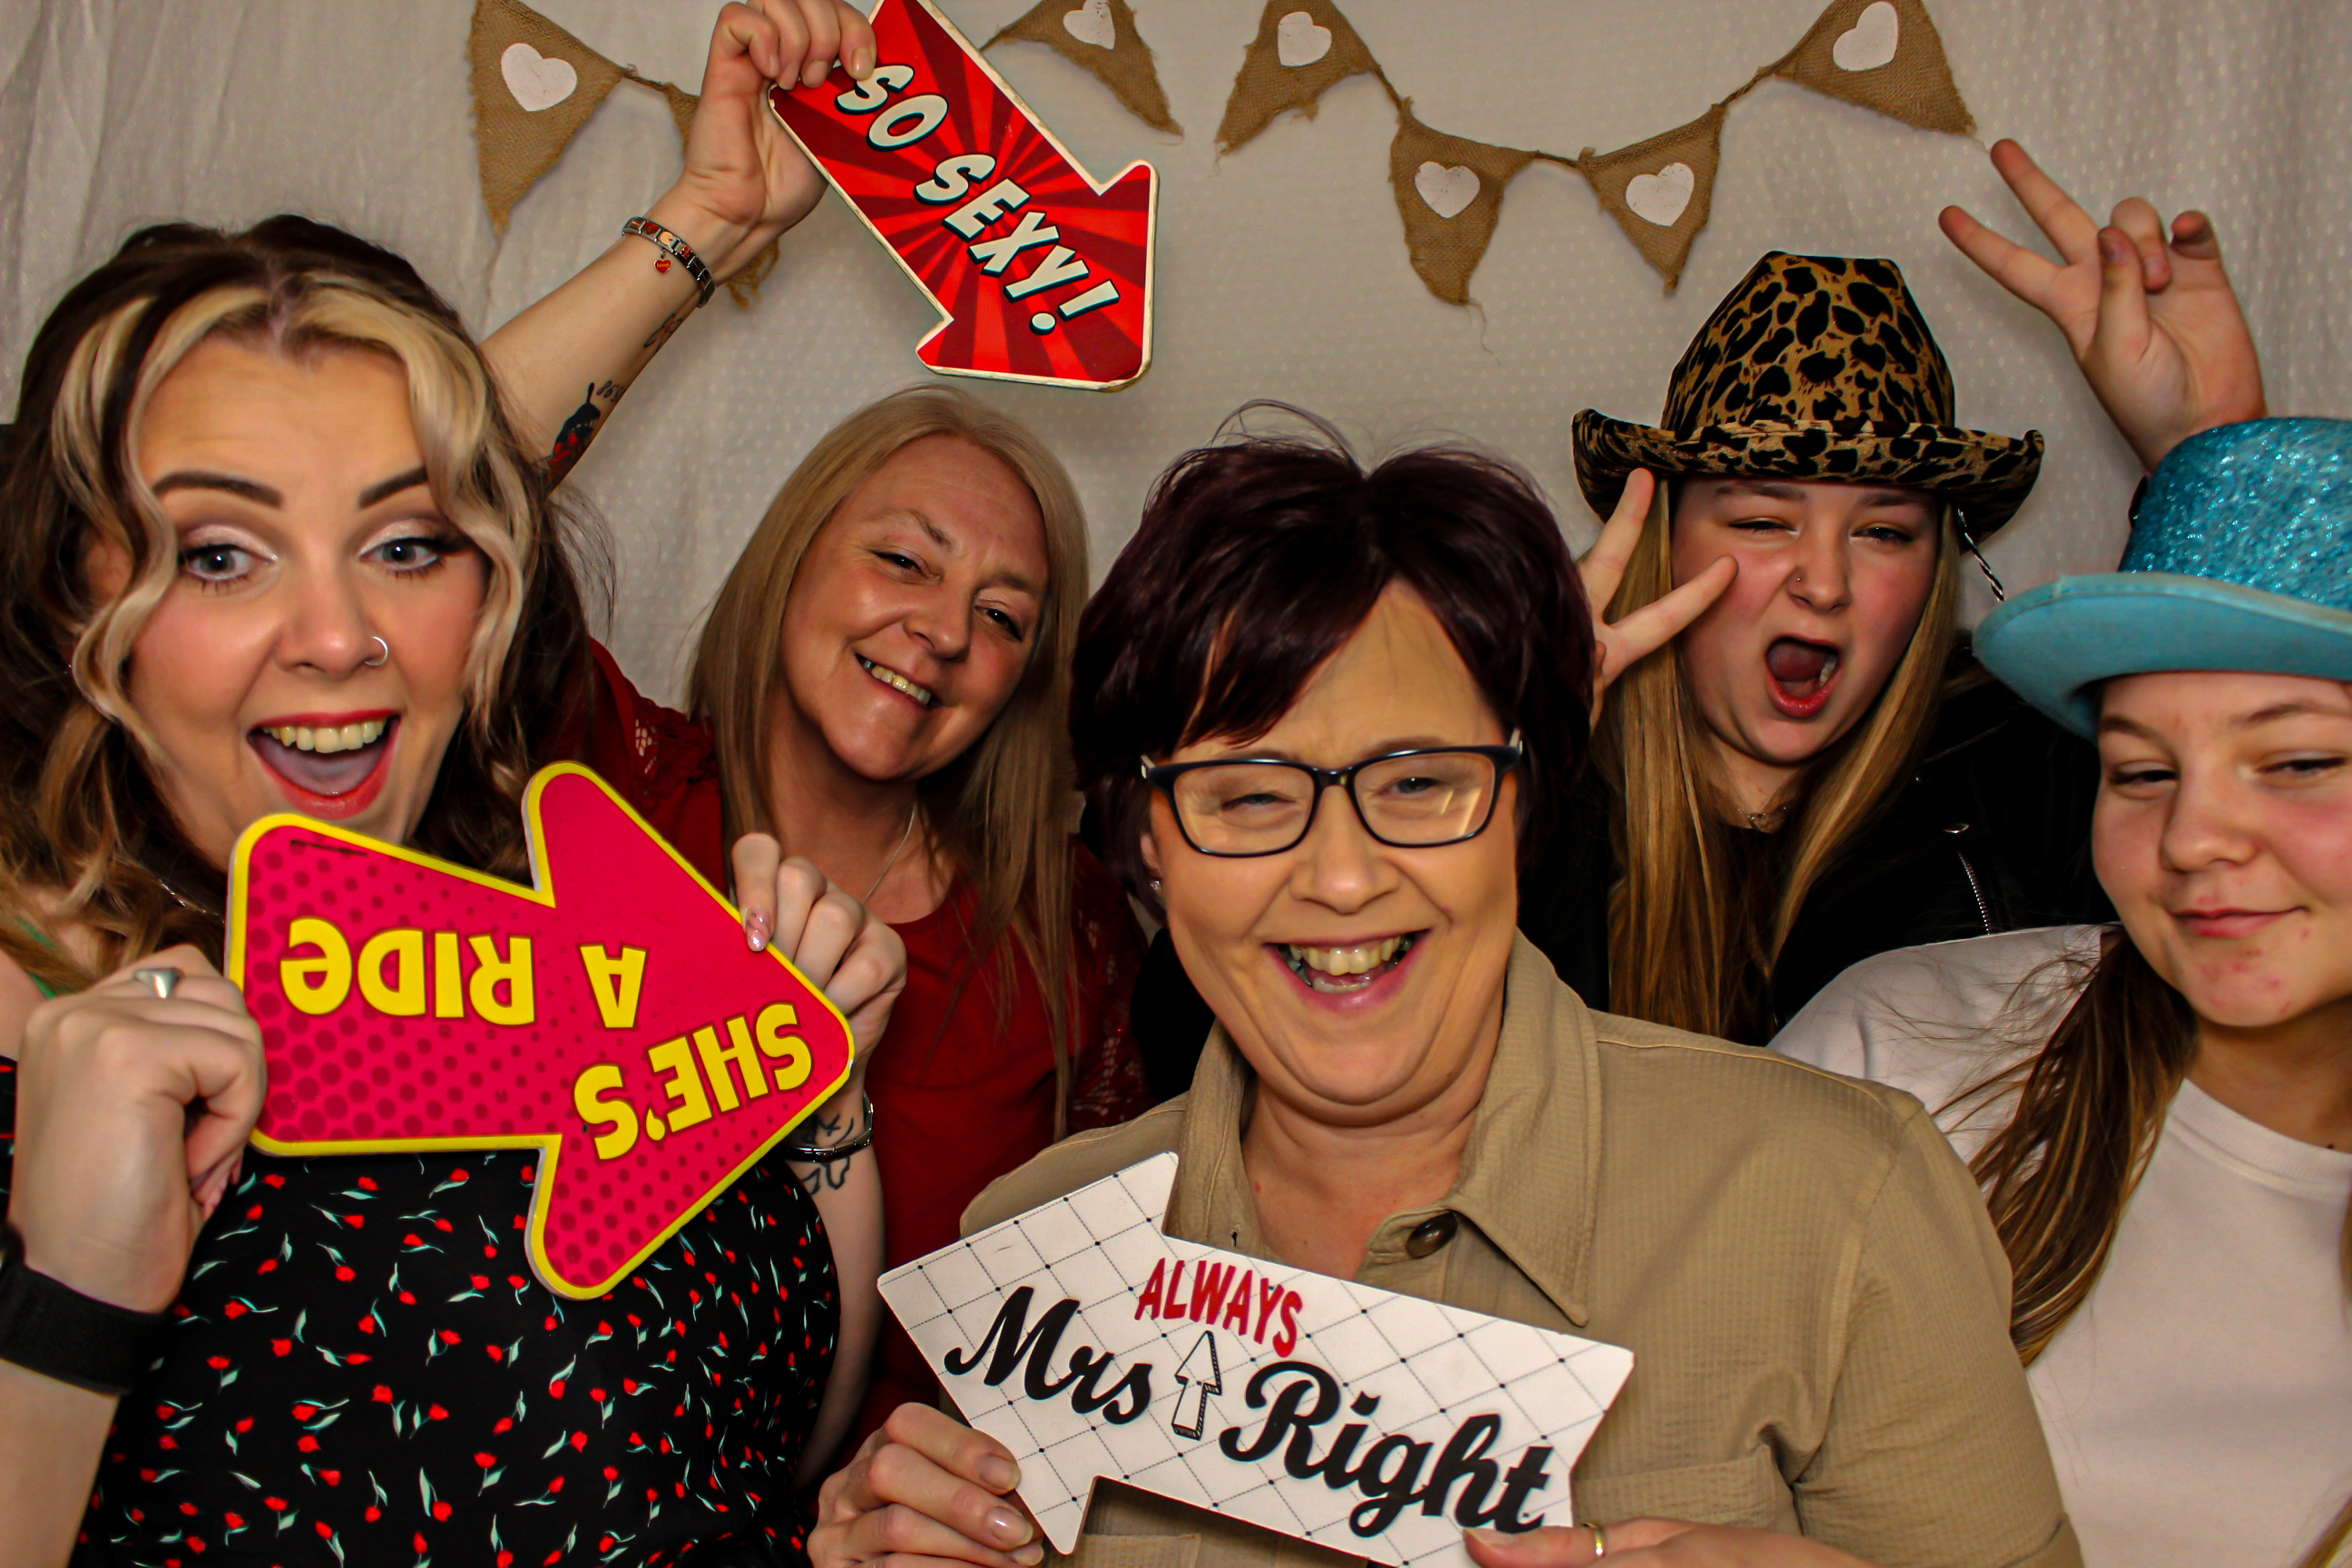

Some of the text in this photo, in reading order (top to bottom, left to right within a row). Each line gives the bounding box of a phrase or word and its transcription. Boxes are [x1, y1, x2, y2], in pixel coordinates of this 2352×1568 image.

[836, 64, 1121, 335] SO SEXY!
[580, 945, 646, 1028] A
[574, 1004, 813, 1160] SHE'S
[1134, 1257, 1304, 1357] ALWAYS
[944, 1287, 1553, 1538] Mrs Right
